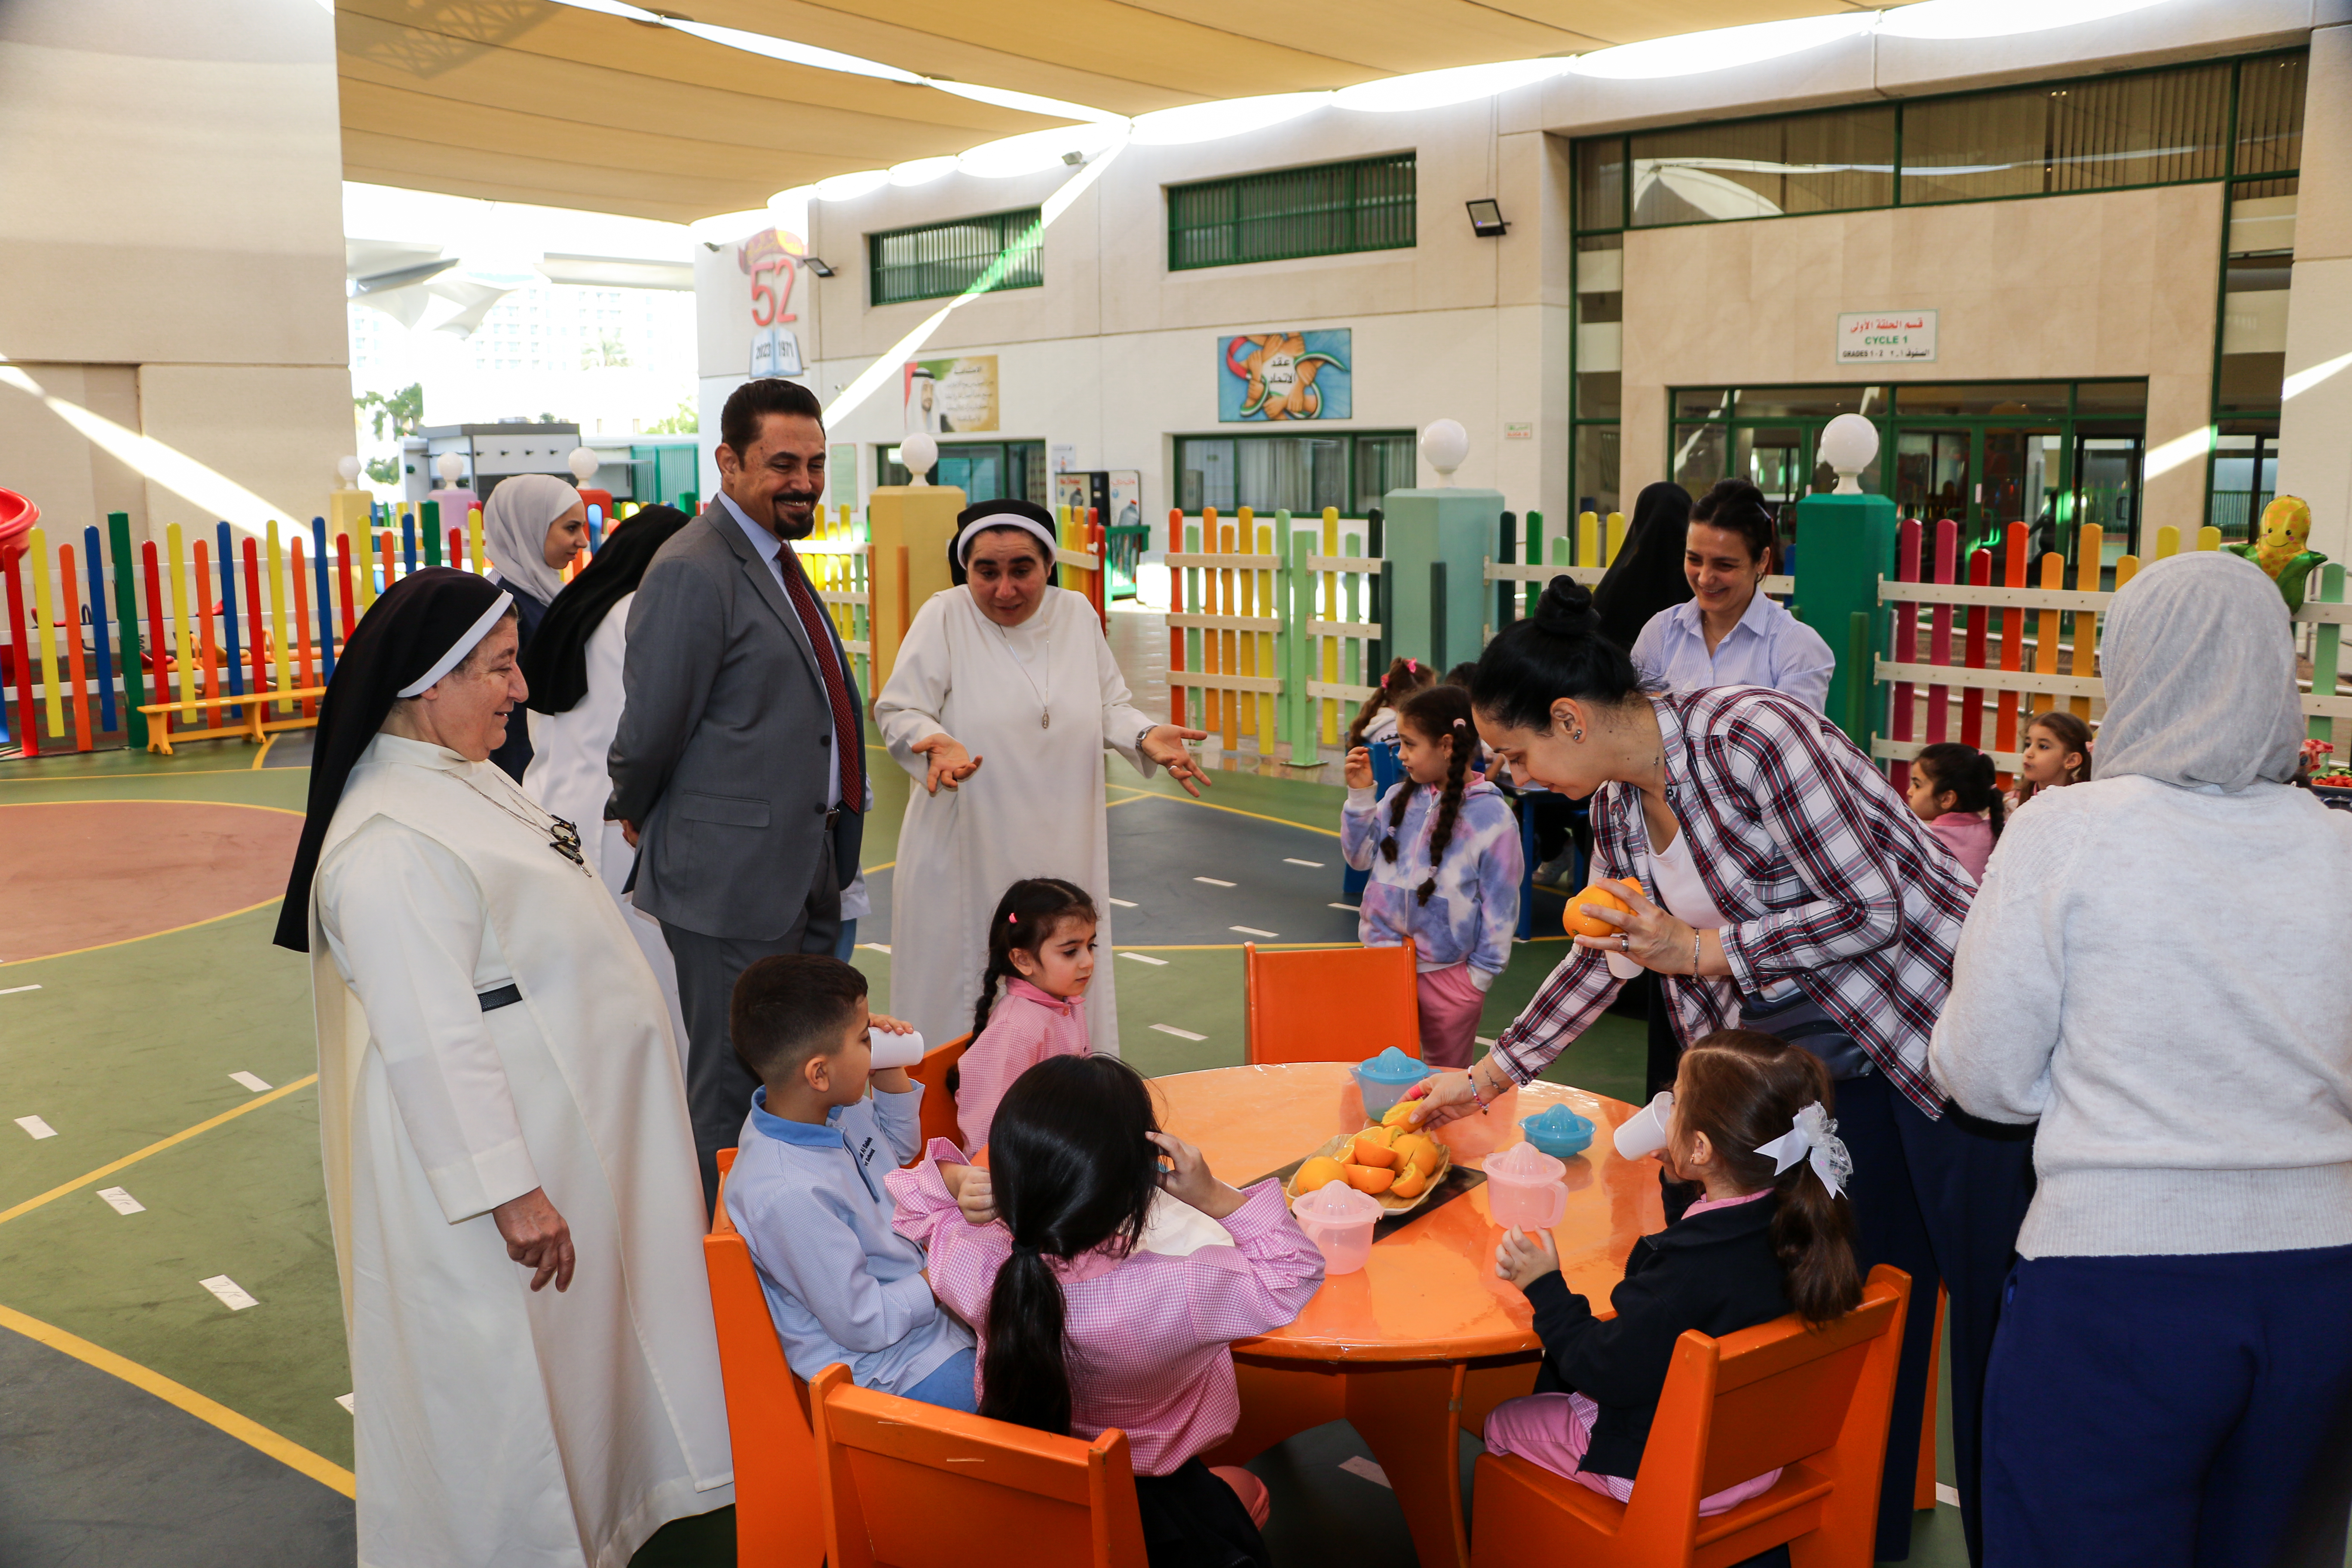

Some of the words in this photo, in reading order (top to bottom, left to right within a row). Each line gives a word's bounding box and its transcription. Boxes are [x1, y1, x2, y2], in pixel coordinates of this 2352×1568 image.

[750, 258, 796, 326] 52
[1850, 319, 1873, 333] الأولى
[1876, 319, 1902, 329] الحلقة
[1905, 317, 1923, 331] قسم
[1865, 336, 1899, 344] CYCLE
[1903, 335, 1908, 343] 1
[756, 342, 771, 359] 2023
[778, 340, 795, 357] 1971
[1905, 348, 1930, 358] الصفوف
[1271, 357, 1290, 366] عقد
[1270, 373, 1296, 383] الاتحاد
[865, 1148, 876, 1162] School
